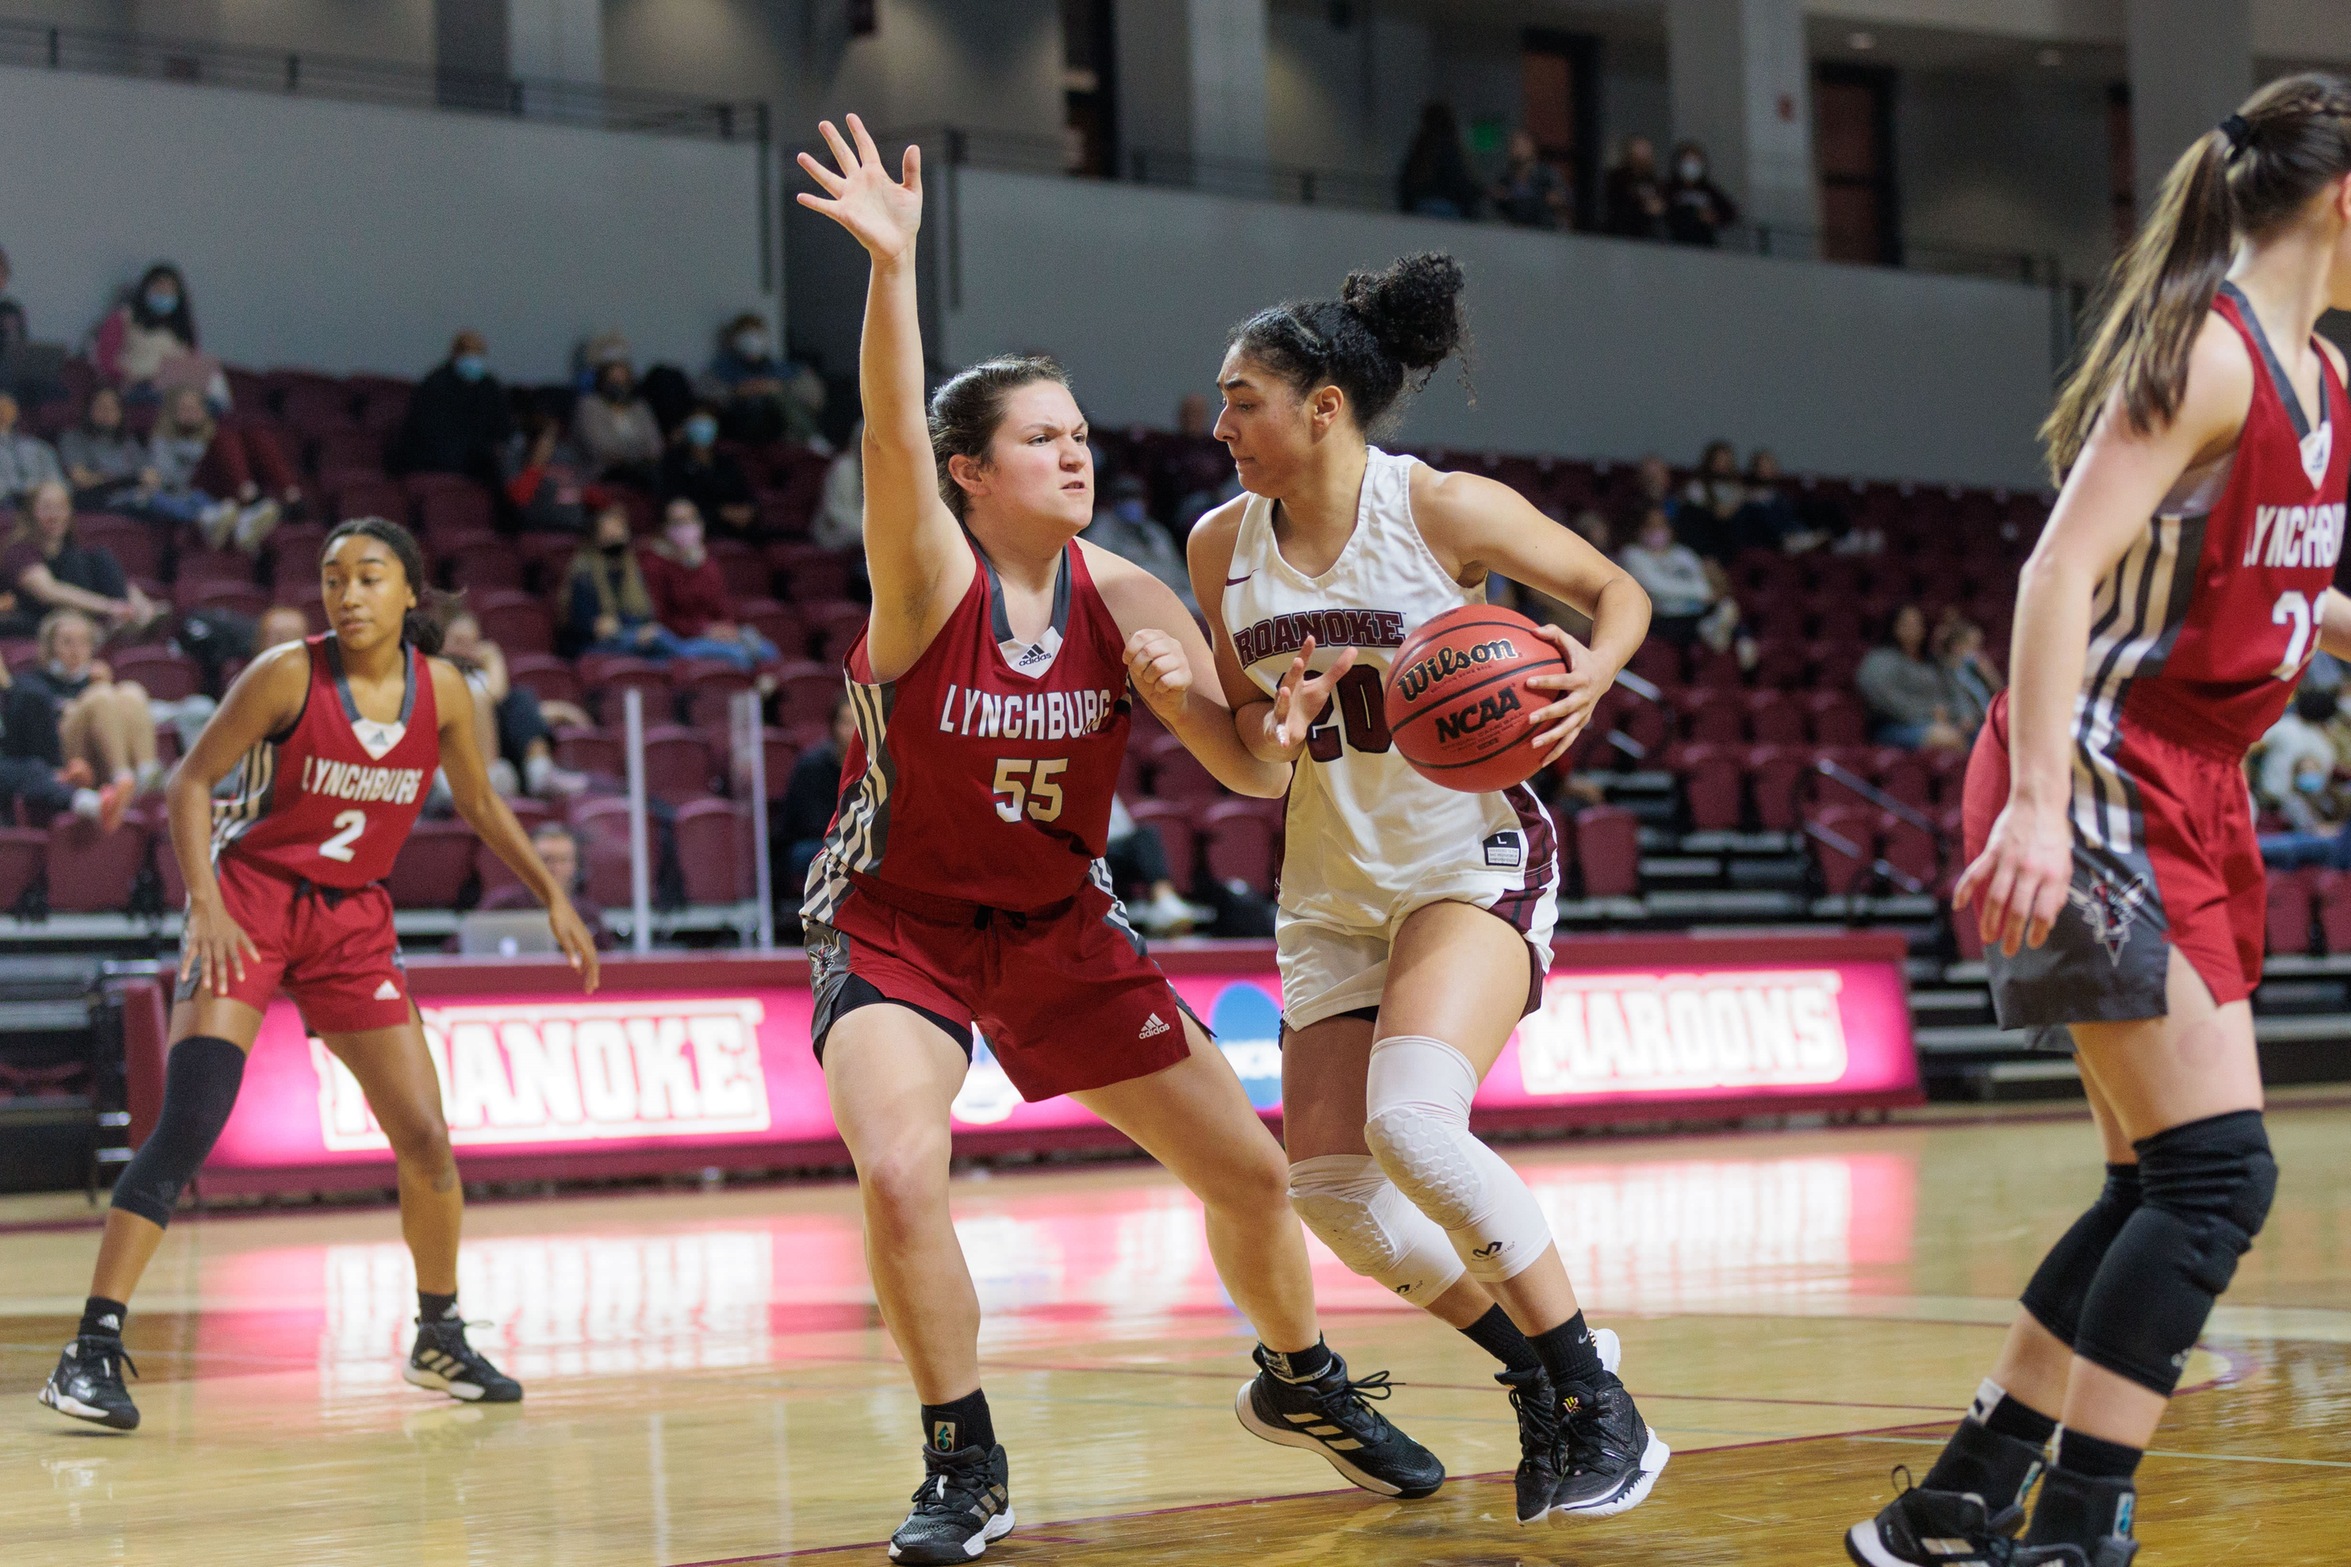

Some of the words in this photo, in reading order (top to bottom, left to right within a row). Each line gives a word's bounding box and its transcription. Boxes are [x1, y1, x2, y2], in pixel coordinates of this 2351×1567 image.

[1019, 652, 1052, 667] adidas
[1233, 609, 1407, 670] ROANOKE
[1398, 638, 1518, 703] Wilson
[1435, 686, 1522, 742] NCAA
[992, 758, 1069, 823] 55
[318, 809, 367, 863] 2
[1496, 835, 1508, 845] L
[1138, 1023, 1170, 1040] adidas
[1520, 974, 1846, 1094] MAROONS
[310, 1001, 769, 1149] ANOKE
